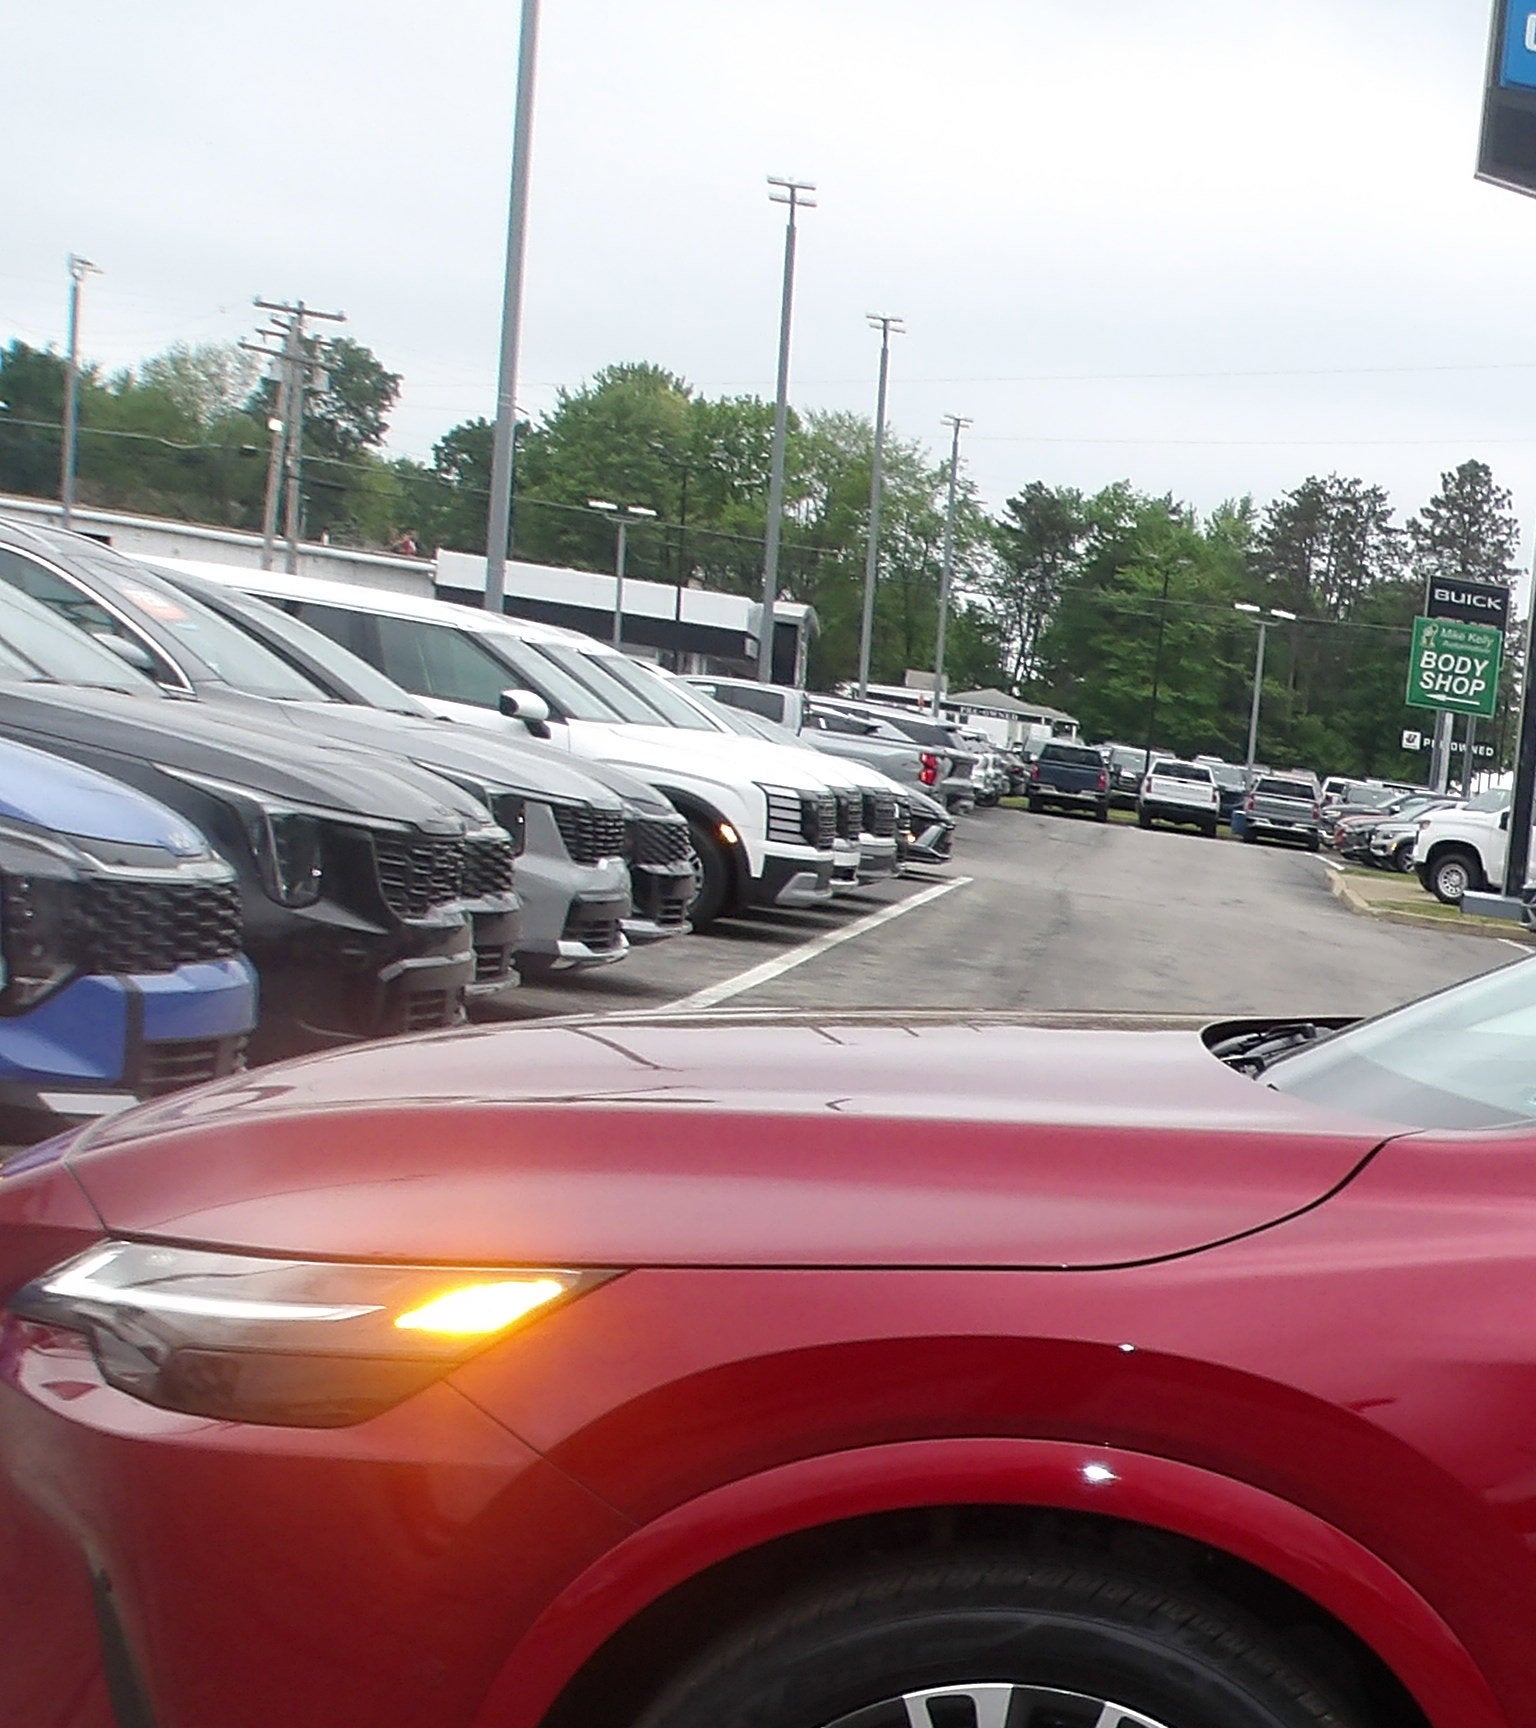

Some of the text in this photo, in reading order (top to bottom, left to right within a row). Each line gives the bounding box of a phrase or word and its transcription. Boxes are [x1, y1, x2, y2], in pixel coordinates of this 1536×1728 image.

[1434, 588, 1502, 610] BUICK
[1420, 650, 1489, 677] BODY
[1419, 671, 1486, 697] SHOP
